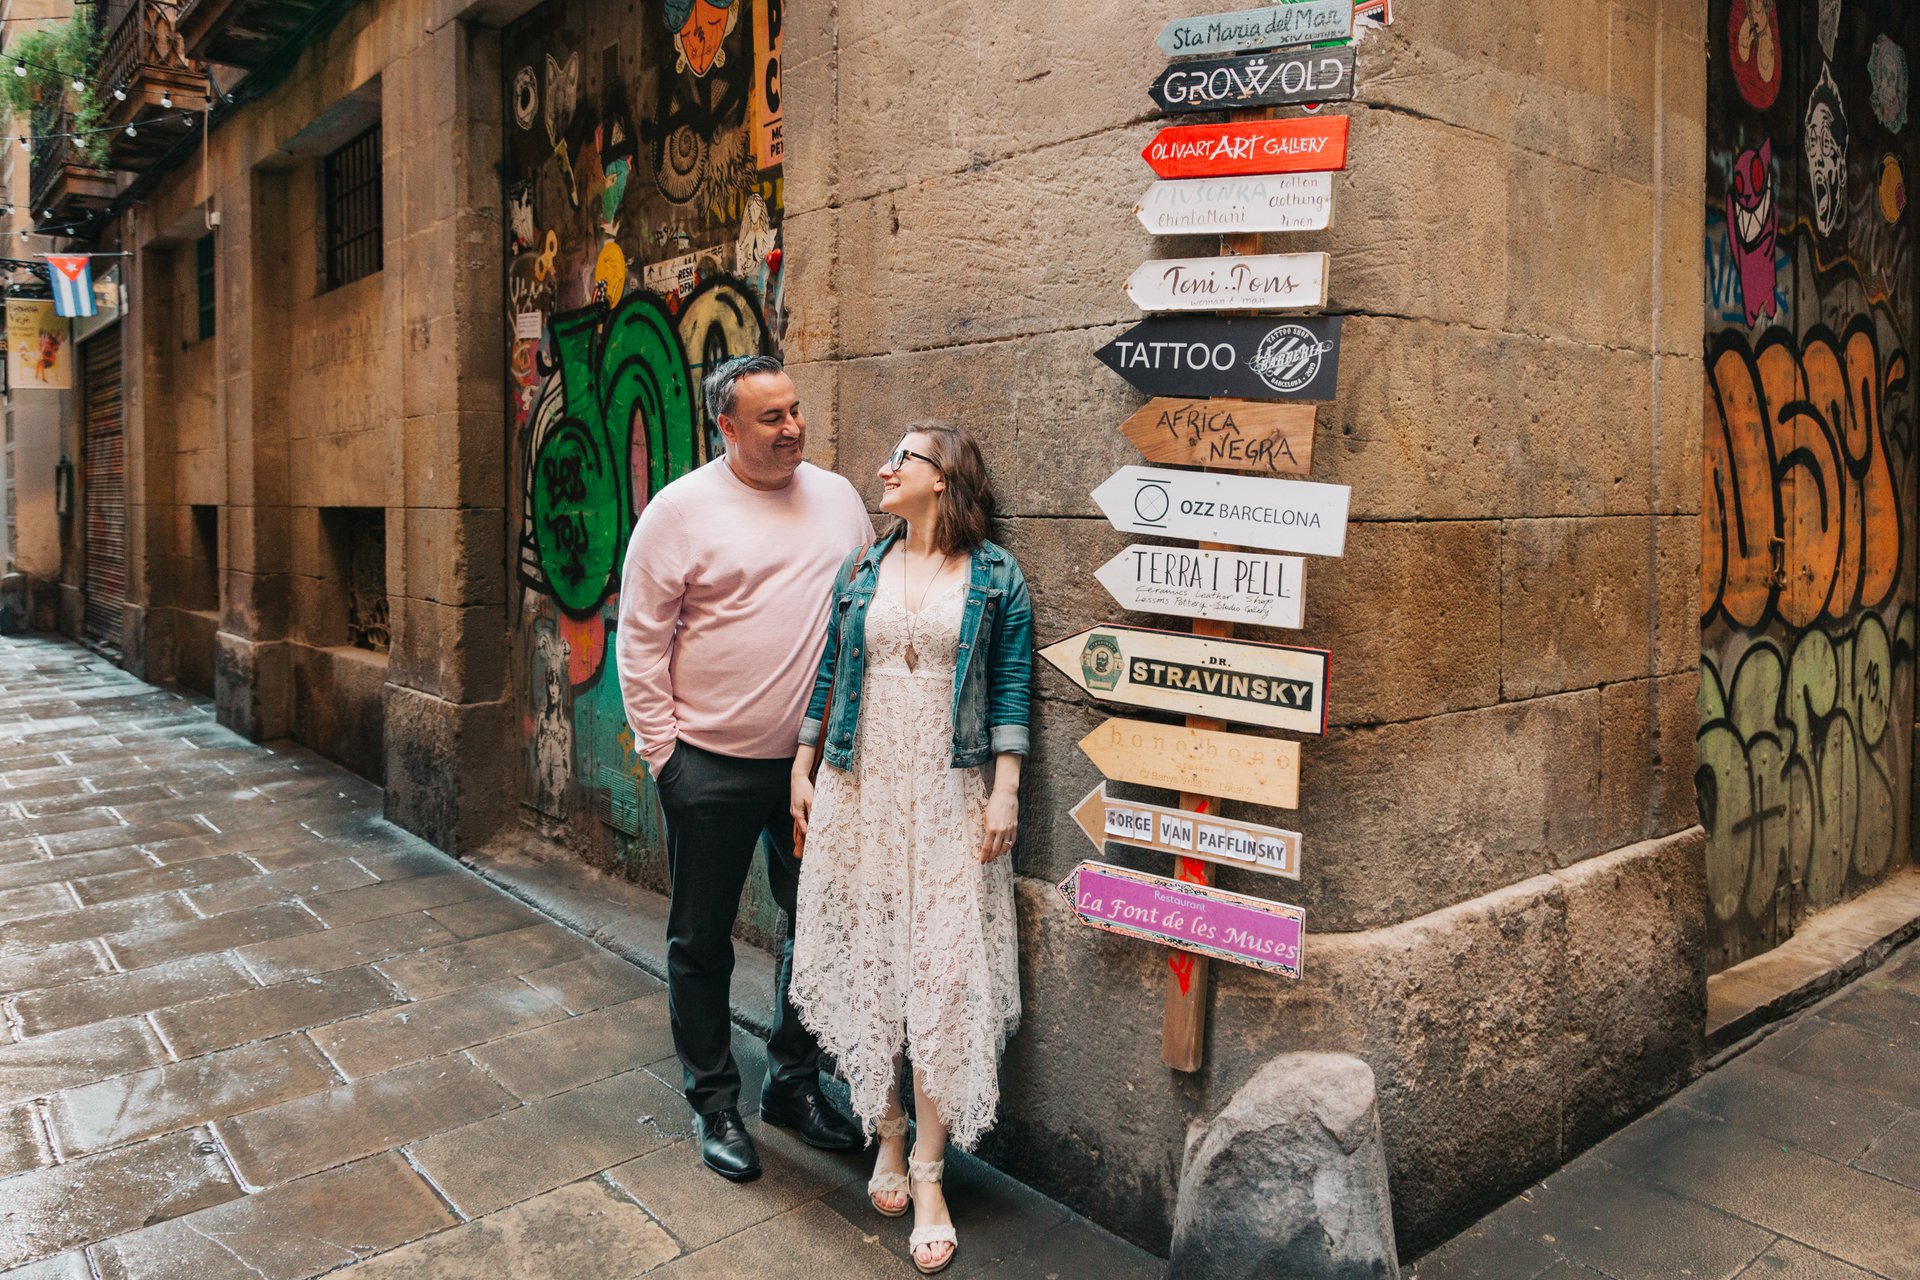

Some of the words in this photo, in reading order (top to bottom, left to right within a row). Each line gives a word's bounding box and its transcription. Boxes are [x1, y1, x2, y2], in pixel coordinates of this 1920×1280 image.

[1173, 27, 1203, 49] Sta
[1207, 18, 1261, 43] Maria
[1264, 10, 1293, 34] del
[1296, 8, 1342, 30] Mar
[1263, 136, 1329, 155] GALLERY
[1266, 327, 1291, 344] TATTOO
[1293, 327, 1310, 339] SHOP
[1115, 341, 1236, 371] TATTOO
[1271, 377, 1302, 388] BARCELONA
[1305, 362, 1316, 378] 2019
[1156, 404, 1240, 440] AFRICA
[1210, 433, 1297, 470] NEGRA
[1219, 503, 1321, 528] BARCELONA
[1132, 551, 1202, 589] TERRA
[1234, 559, 1291, 598] PELL
[1209, 656, 1231, 667] DR.
[1132, 661, 1310, 706] STRAVINSKY
[1865, 660, 1880, 703] 19
[1162, 823, 1191, 842] VAN
[1200, 832, 1284, 861] PAFFLINSKY
[1154, 890, 1206, 912] Restaurant
[1078, 892, 1103, 912] La
[1107, 898, 1158, 924] Font
[1162, 911, 1184, 930] de
[1191, 916, 1217, 939] les
[1222, 928, 1298, 959] Muses
